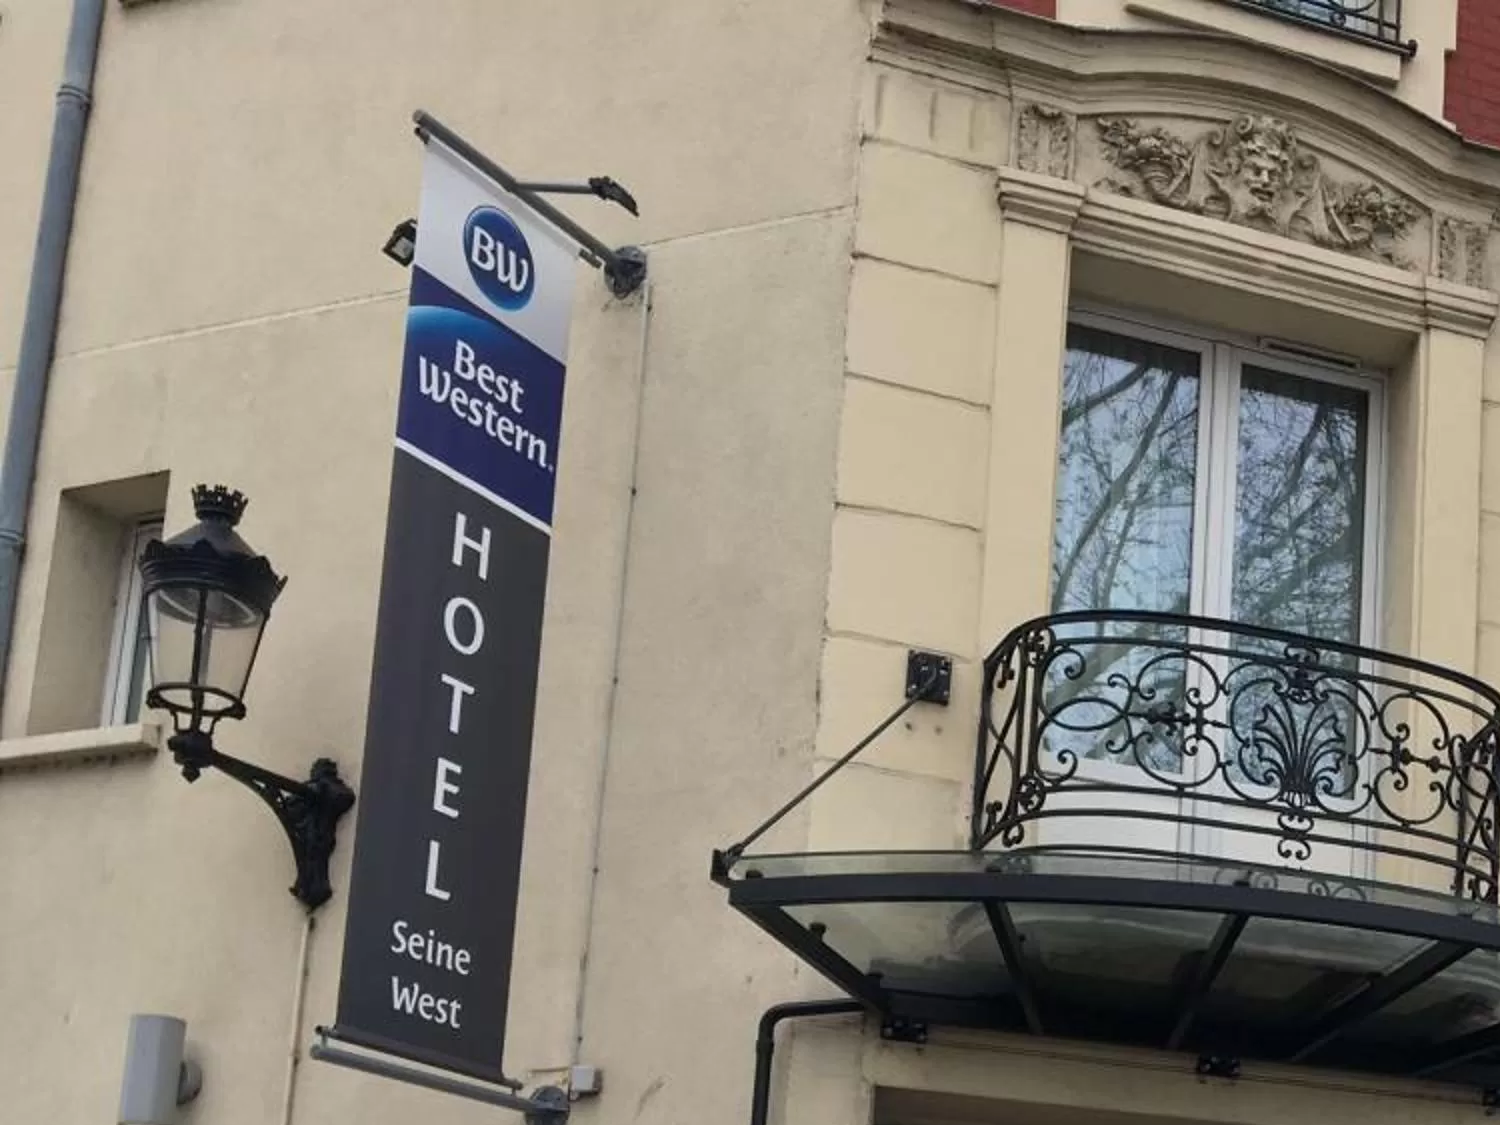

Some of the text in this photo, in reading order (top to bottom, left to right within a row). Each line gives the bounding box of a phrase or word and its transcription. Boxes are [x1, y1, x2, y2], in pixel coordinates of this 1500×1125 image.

[470, 226, 530, 291] BW
[454, 340, 525, 414] Best
[425, 512, 491, 901] HOTEL
[391, 920, 471, 975] Seine
[391, 976, 461, 1029] West
